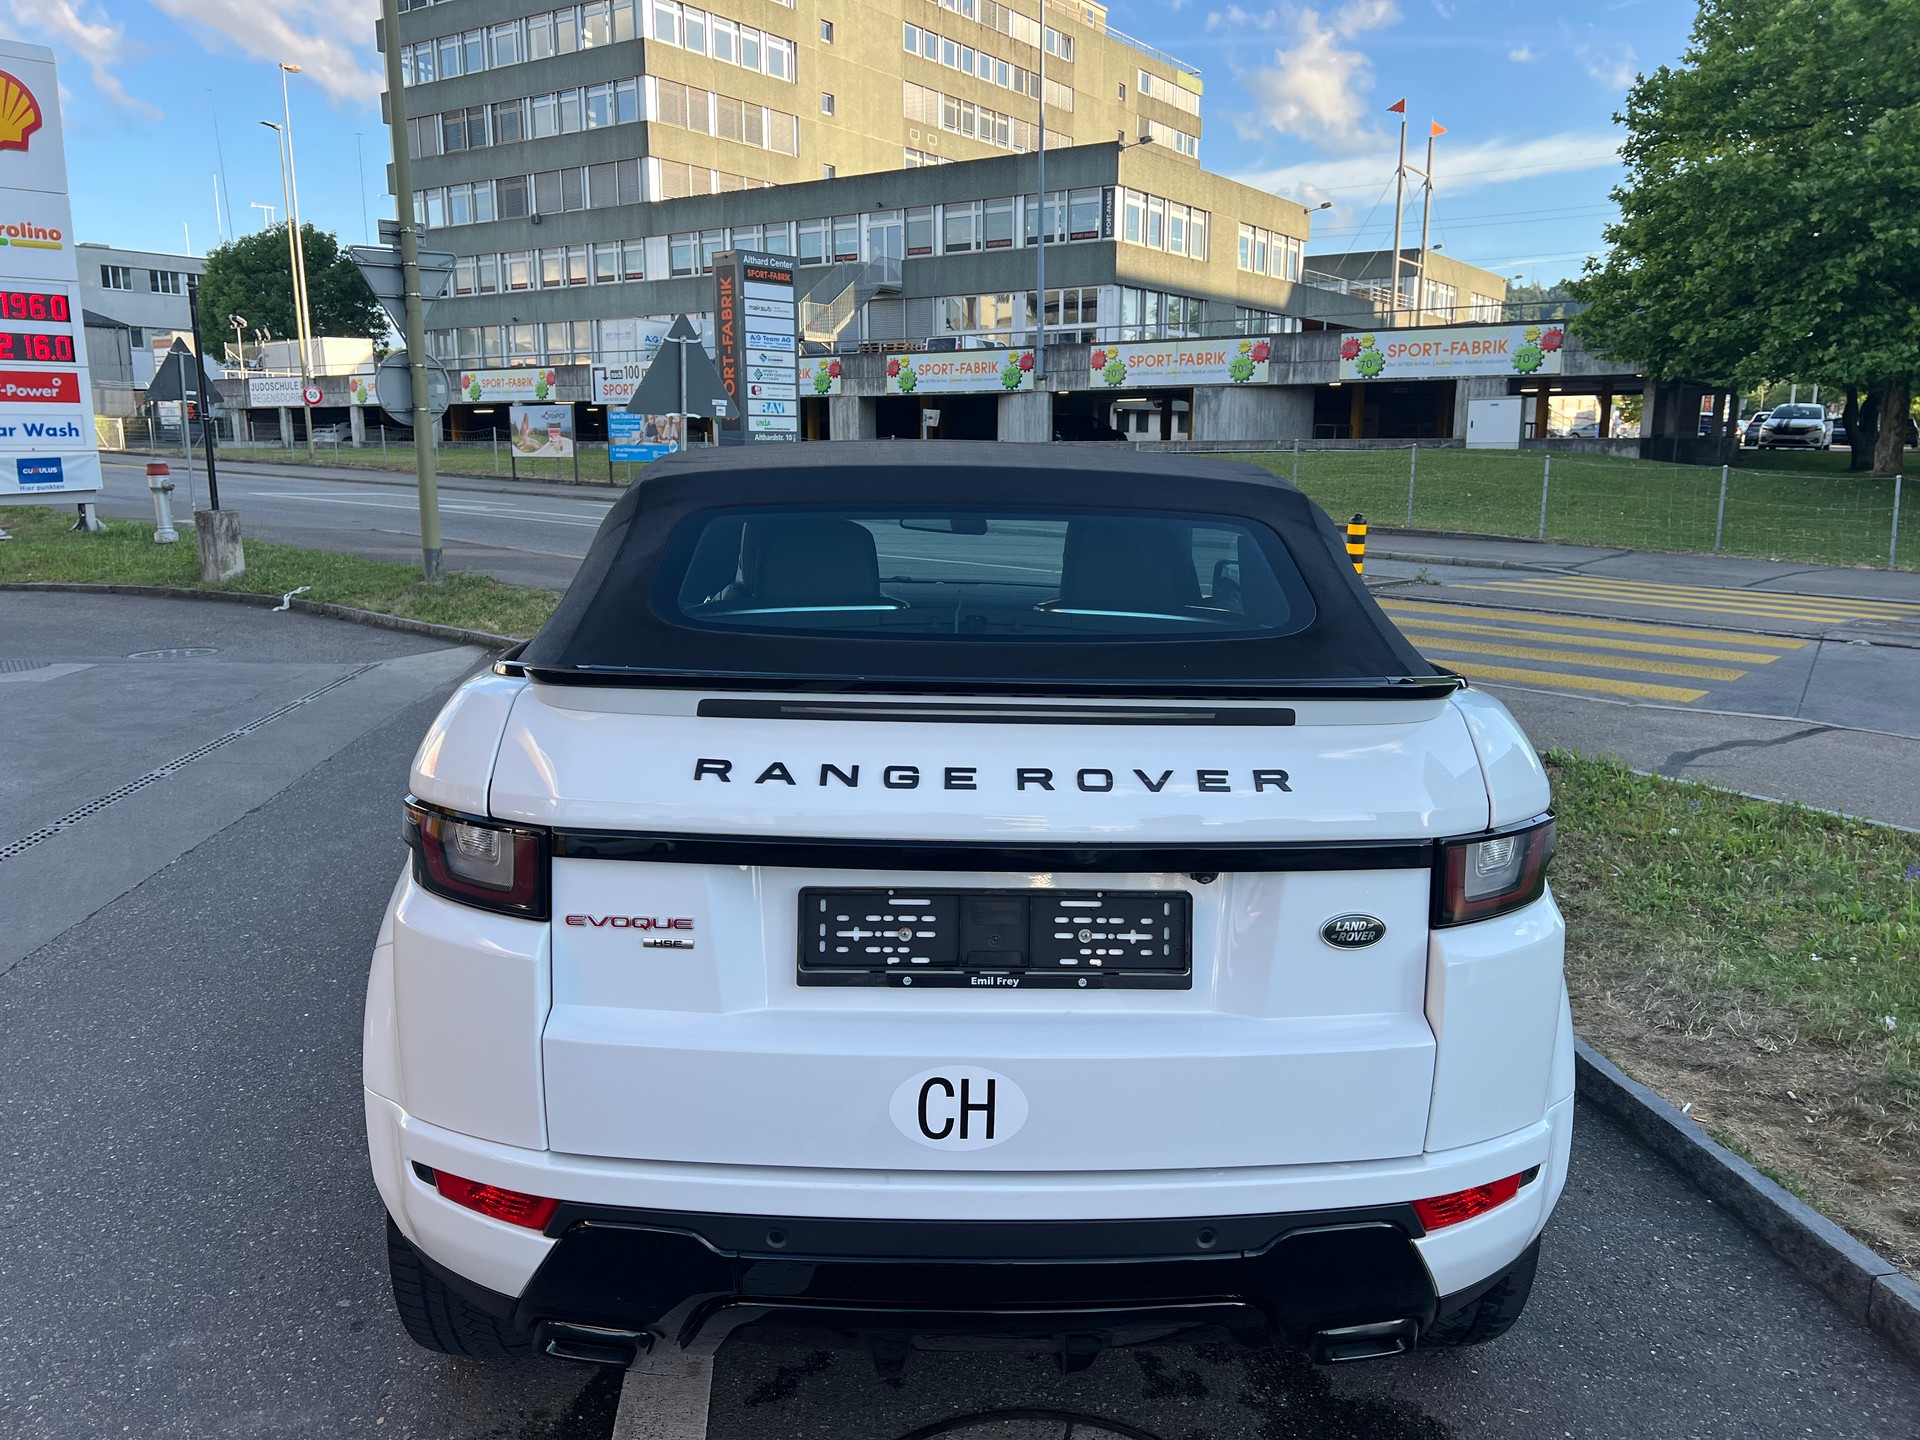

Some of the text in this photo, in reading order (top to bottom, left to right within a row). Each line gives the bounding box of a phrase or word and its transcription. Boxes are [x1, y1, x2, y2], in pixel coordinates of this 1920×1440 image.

[1104, 190, 1114, 235] SPORT-FABRIK
[743, 255, 793, 269] Althard Center
[747, 269, 791, 282] SPORT-FABRIK
[720, 276, 737, 420] ORT-FABRIK
[1387, 340, 1508, 358] SPORT-FABRIK
[1129, 352, 1226, 368] SPORT-FABRIK
[1361, 358, 1380, 369] 70%
[1516, 352, 1538, 365] 70%
[624, 365, 640, 379] 100
[918, 361, 998, 376] SPORT-FABRIK
[1106, 369, 1122, 378] 70%
[1232, 363, 1250, 374] 70%
[481, 378, 533, 388] SPORT-FABRIK
[900, 376, 914, 384] 70%
[1003, 372, 1018, 381] 70%
[0, 383, 59, 397] -Power
[251, 381, 299, 391] JUDOSCHULE
[252, 393, 299, 403] REGENSDORF
[22, 422, 79, 437] Wash
[37, 484, 65, 492] punkten
[694, 758, 1294, 793] RANGE ROVER
[565, 914, 695, 931] EVOQUE
[1335, 921, 1367, 931] LAND
[1338, 931, 1375, 941] ROVER
[653, 940, 683, 948] HSE
[971, 977, 1019, 987] Emil Frey
[917, 1077, 996, 1140] CH
